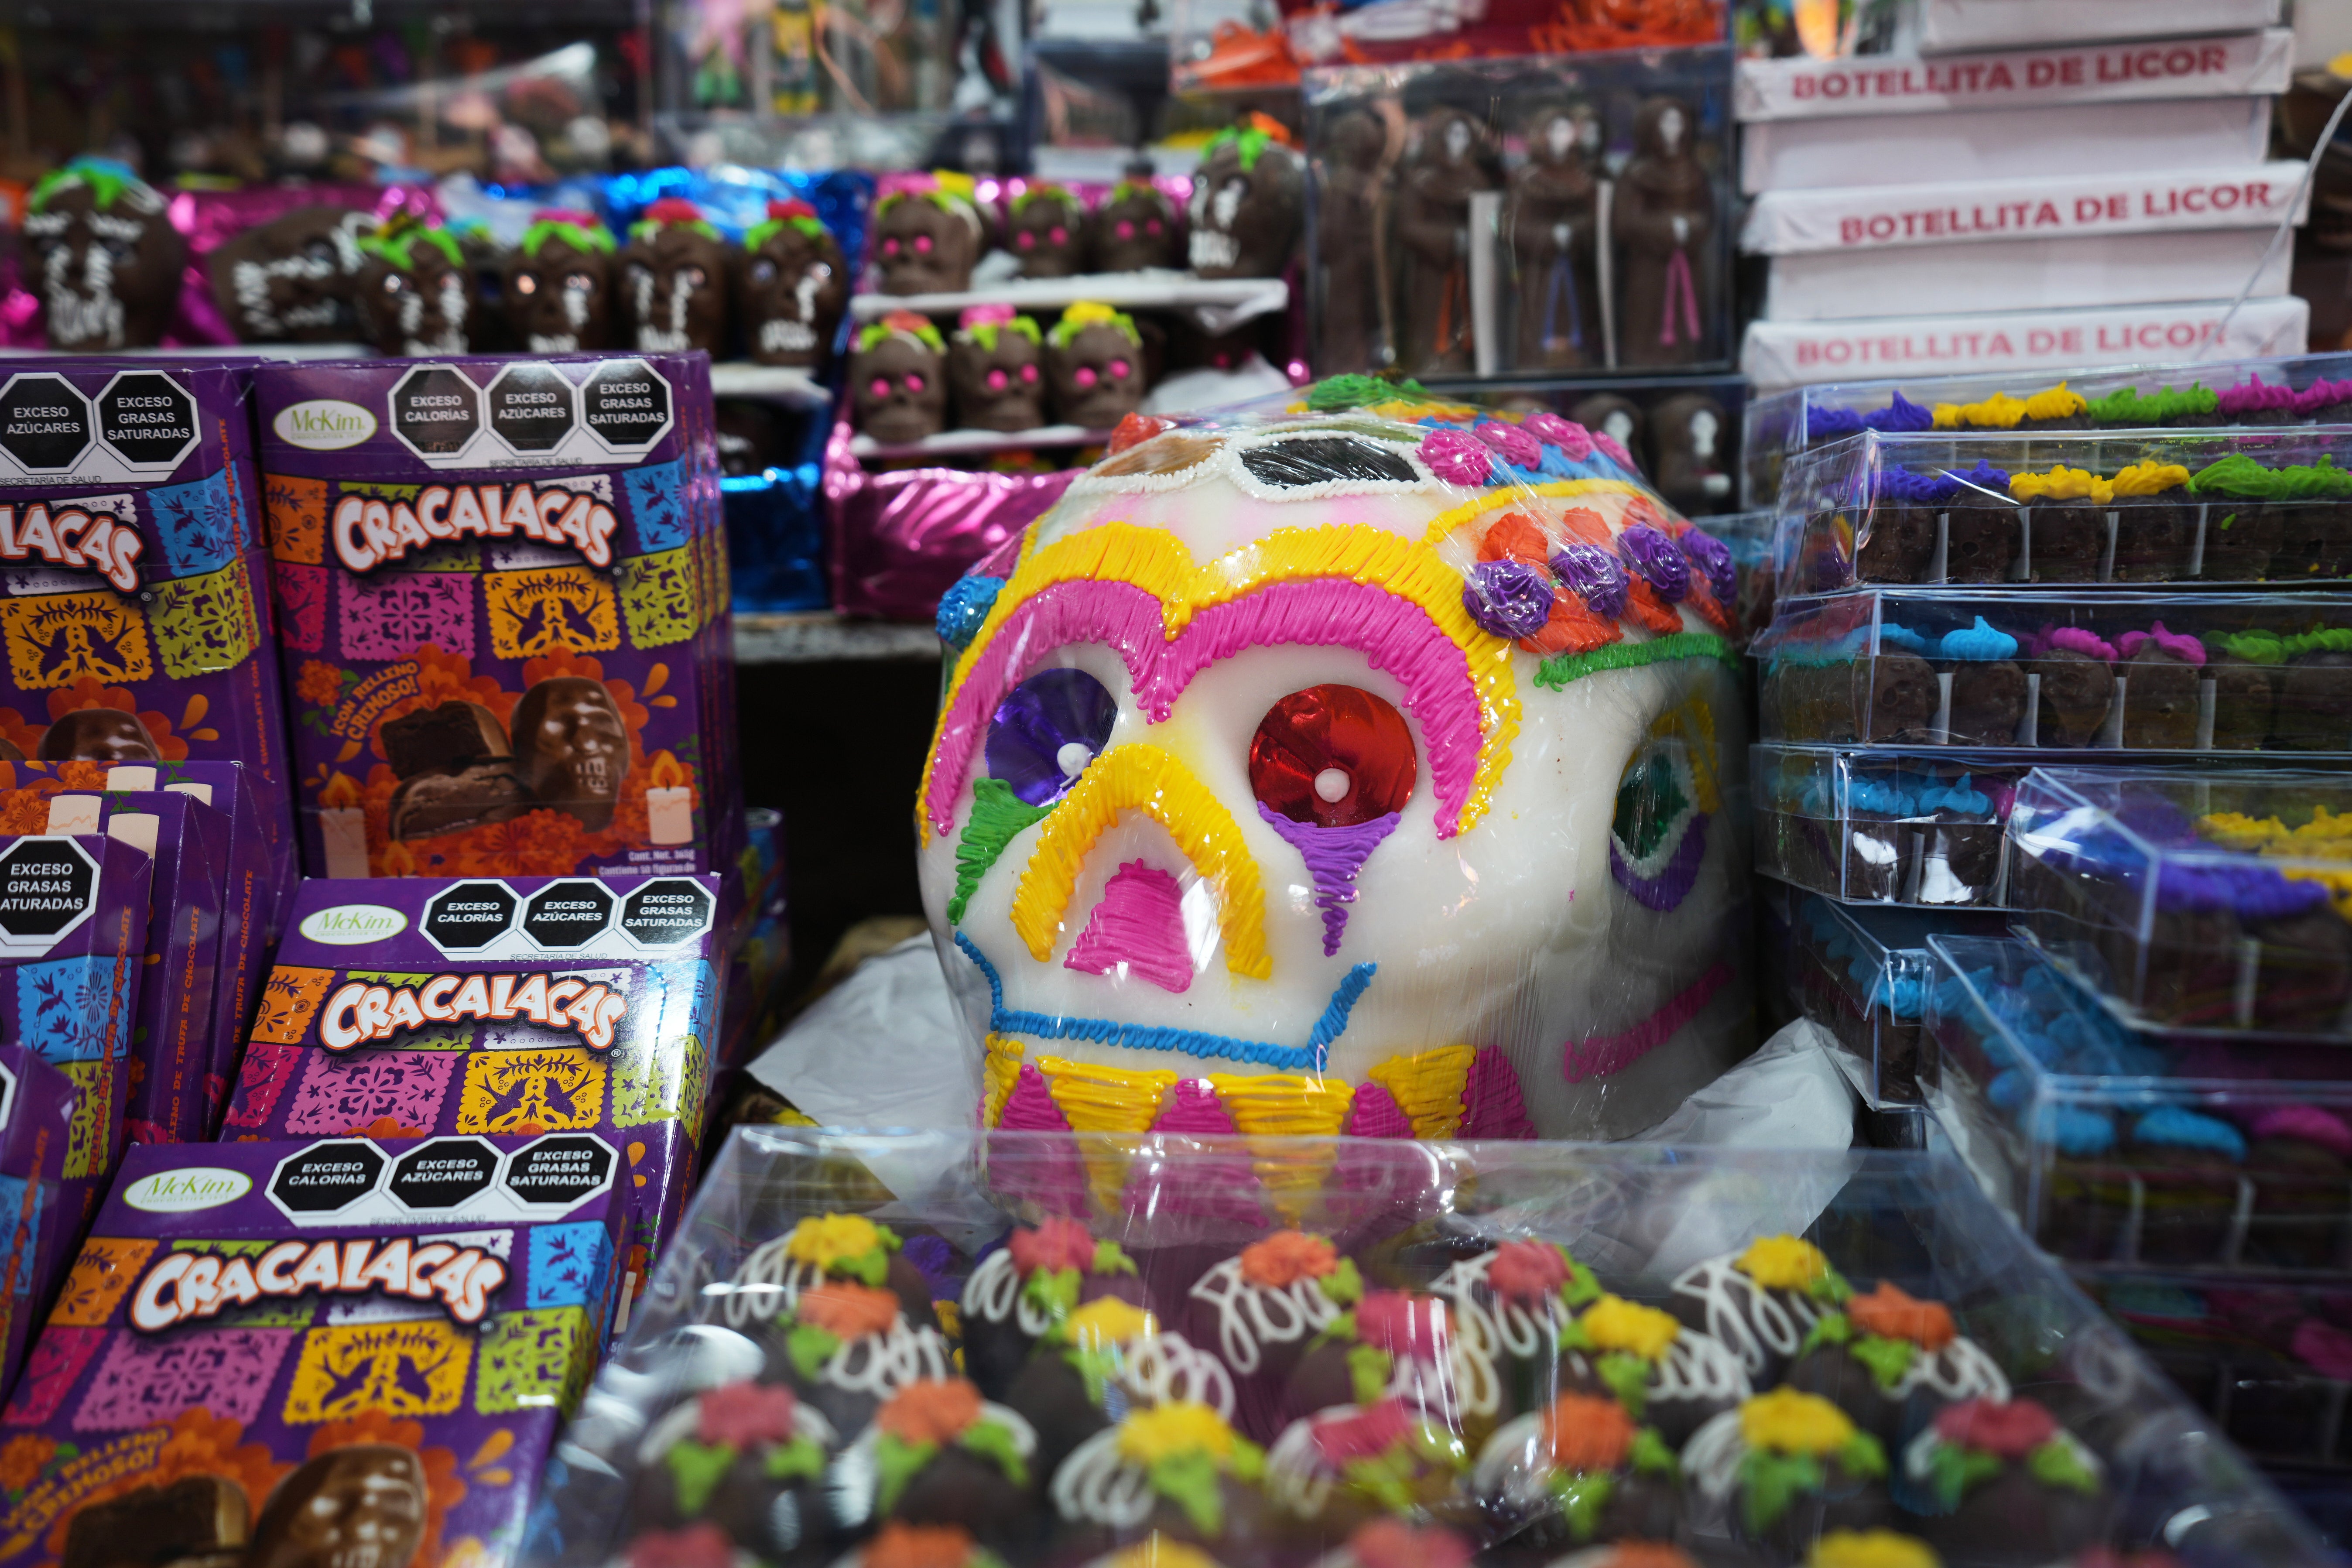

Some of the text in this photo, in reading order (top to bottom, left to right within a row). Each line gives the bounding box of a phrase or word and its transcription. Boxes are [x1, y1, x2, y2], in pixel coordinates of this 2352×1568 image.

[1792, 45, 2228, 100] BOTELLITA DE LICOR
[1840, 183, 2272, 245] BOTELLITA DE LICOR
[1795, 320, 2227, 368] BOTELLITA DE LICOR
[600, 383, 650, 394] EXCESO
[117, 396, 172, 408] EXCESO
[411, 395, 462, 407] EXCESO
[506, 393, 557, 404] EXCESO
[600, 397, 653, 409] GRASAS
[14, 406, 69, 418] EXCESO
[118, 412, 175, 425] GRASAS
[405, 408, 470, 422] CALORÍAS
[499, 406, 566, 419] AZÚCARES
[589, 412, 665, 425] SATURADAS
[291, 409, 363, 431] McKim
[7, 421, 80, 434] AZÚCARES
[108, 428, 190, 441] SATURADAS
[219, 418, 235, 496] CHOCOLATE
[72, 476, 102, 484] SALUD
[229, 500, 238, 519] DE
[332, 483, 617, 572] CRACALACAS
[238, 567, 246, 587] DE
[251, 660, 260, 687] CON
[352, 661, 418, 700] RELLENO
[347, 675, 418, 740] CREMOSO!
[10, 863, 73, 876] EXCESO
[7, 880, 72, 893] GRASAS
[0, 897, 84, 911] ATURADAS
[544, 900, 597, 910] EXCESO
[642, 894, 695, 904] EXCESO
[240, 870, 253, 948] CHOCOLATE
[447, 901, 500, 911] EXCESO
[640, 906, 692, 915] GRASAS
[317, 912, 392, 930] McKim
[438, 911, 503, 922] CALORÍAS
[532, 911, 603, 921] AZÚCARES
[625, 918, 702, 928] SATURADAS
[113, 905, 132, 993] CHOCOLATE
[238, 953, 247, 971] DE
[234, 977, 245, 1020] TRUFA
[109, 996, 120, 1017] DE
[320, 974, 627, 1050] CRACALACAS
[168, 905, 200, 1143] LLENO DE TRUFA DE CHOCOLATE
[233, 1025, 242, 1044] DE
[103, 1023, 117, 1072] TRUFA
[98, 1075, 110, 1099] DE
[88, 1102, 106, 1176] RELLENO
[532, 1150, 593, 1161] EXCESO
[302, 1162, 363, 1173] EXCESO
[417, 1159, 478, 1170] EXCESO
[528, 1162, 590, 1173] GRASAS
[289, 1174, 366, 1186] CALORÍAS
[401, 1171, 483, 1184] AZÚCARES
[509, 1175, 601, 1187] SATURADAS
[145, 1175, 235, 1196] McKim
[131, 1237, 507, 1331] CRACALACAS
